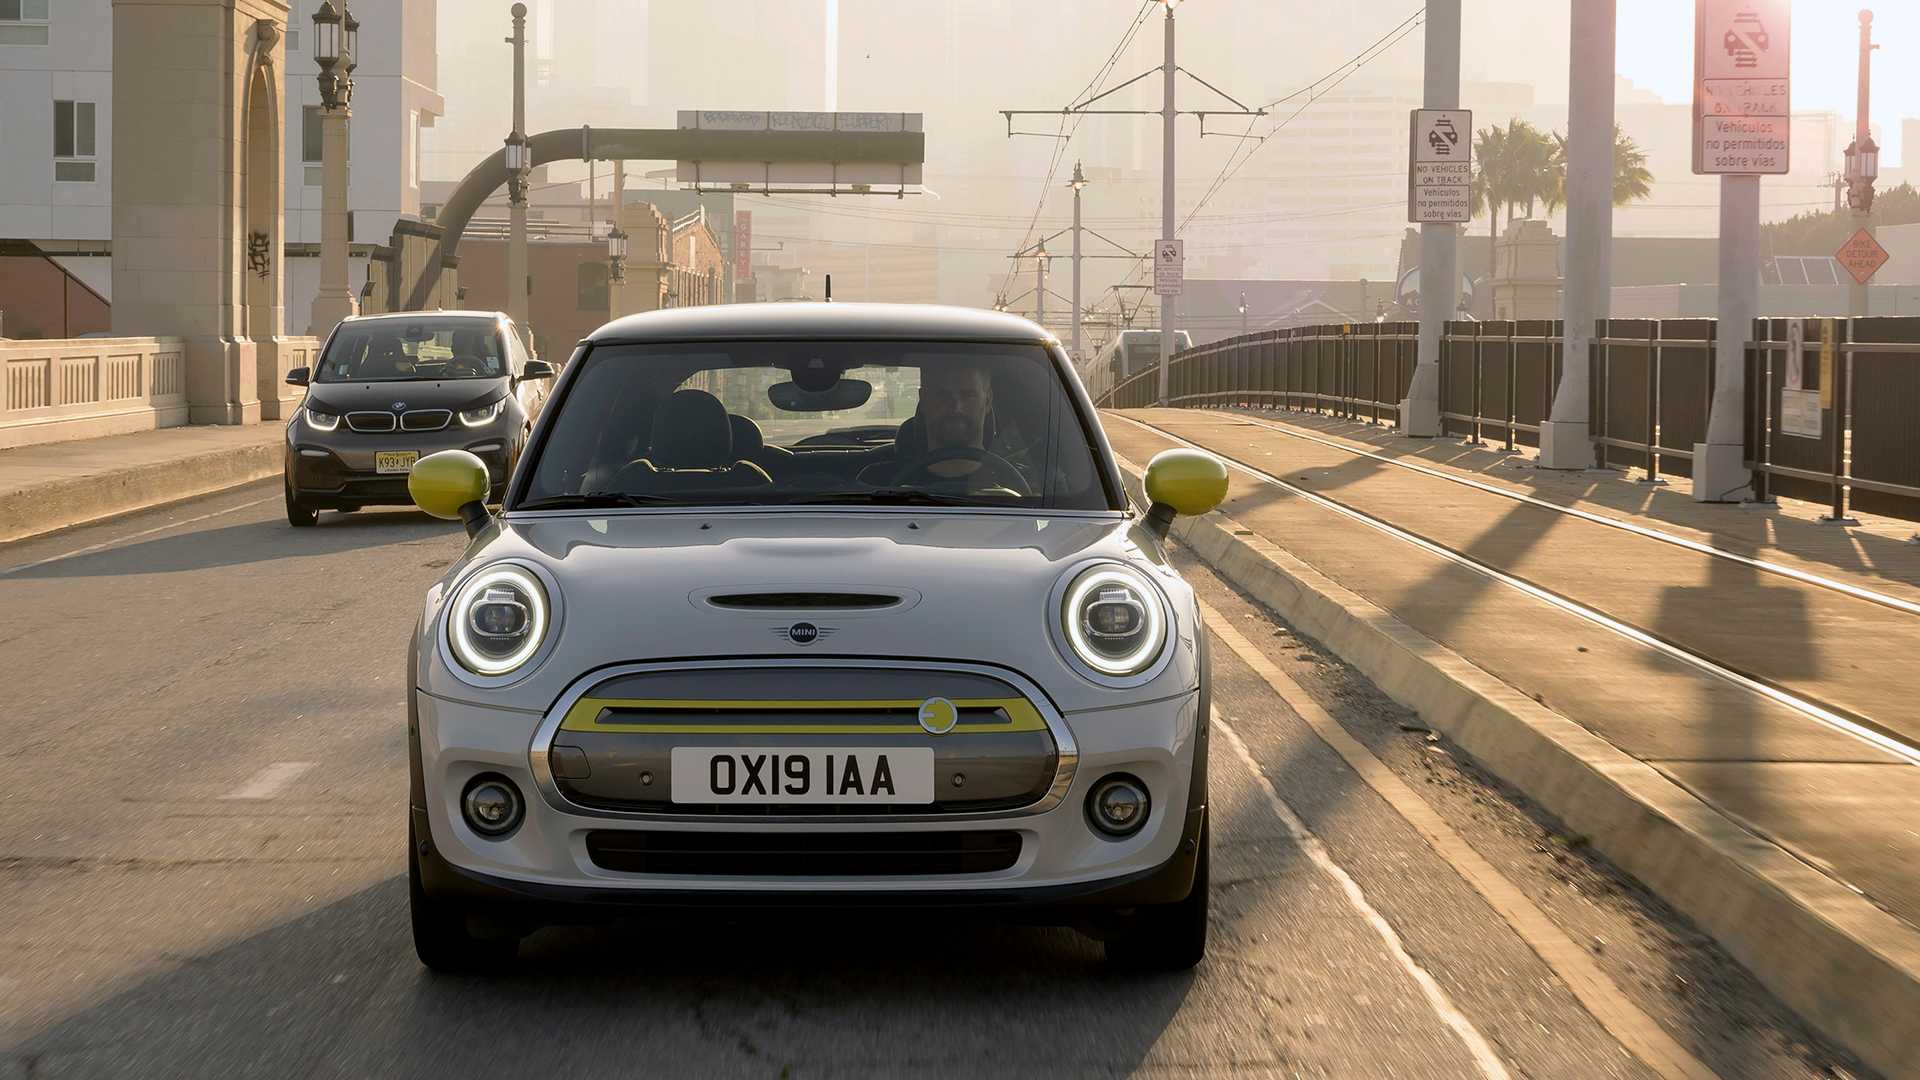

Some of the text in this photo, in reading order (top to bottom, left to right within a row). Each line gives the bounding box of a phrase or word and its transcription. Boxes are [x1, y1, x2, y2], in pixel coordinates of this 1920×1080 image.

[1728, 84, 1786, 96] EHLES
[1736, 102, 1777, 113] RACK
[1705, 138, 1785, 152] no permitidos
[1715, 154, 1748, 167] sobre
[1417, 165, 1469, 173] NO VEHICLES
[1423, 210, 1445, 218] sobre
[791, 628, 816, 636] MINI
[710, 754, 811, 796] OX19
